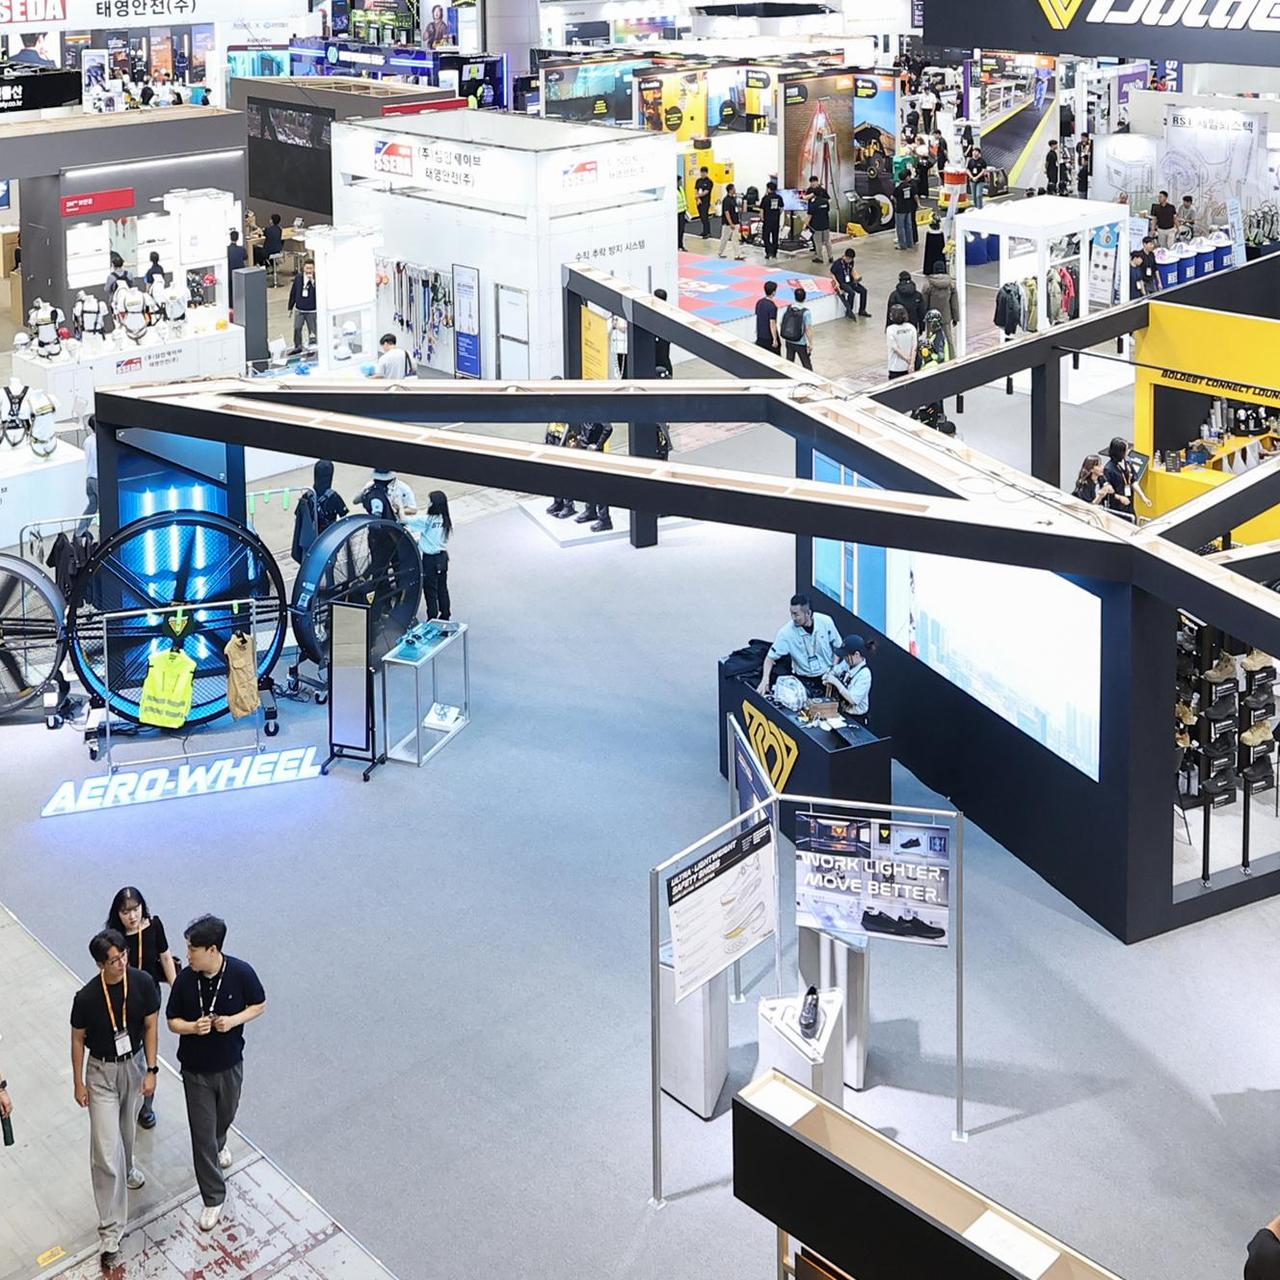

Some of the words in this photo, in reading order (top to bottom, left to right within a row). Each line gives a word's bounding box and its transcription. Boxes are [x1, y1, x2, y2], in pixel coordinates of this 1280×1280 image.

[575, 250, 590, 262] 수직
[608, 244, 623, 256] 방지
[625, 239, 646, 251] 시스템
[1161, 369, 1204, 385] BOLDEST
[1205, 378, 1251, 395] CONNECT
[41, 746, 321, 817] AERO-WHEEL
[801, 853, 859, 872] WORK
[671, 874, 698, 896] SAFETY
[803, 872, 863, 893] MOVE
